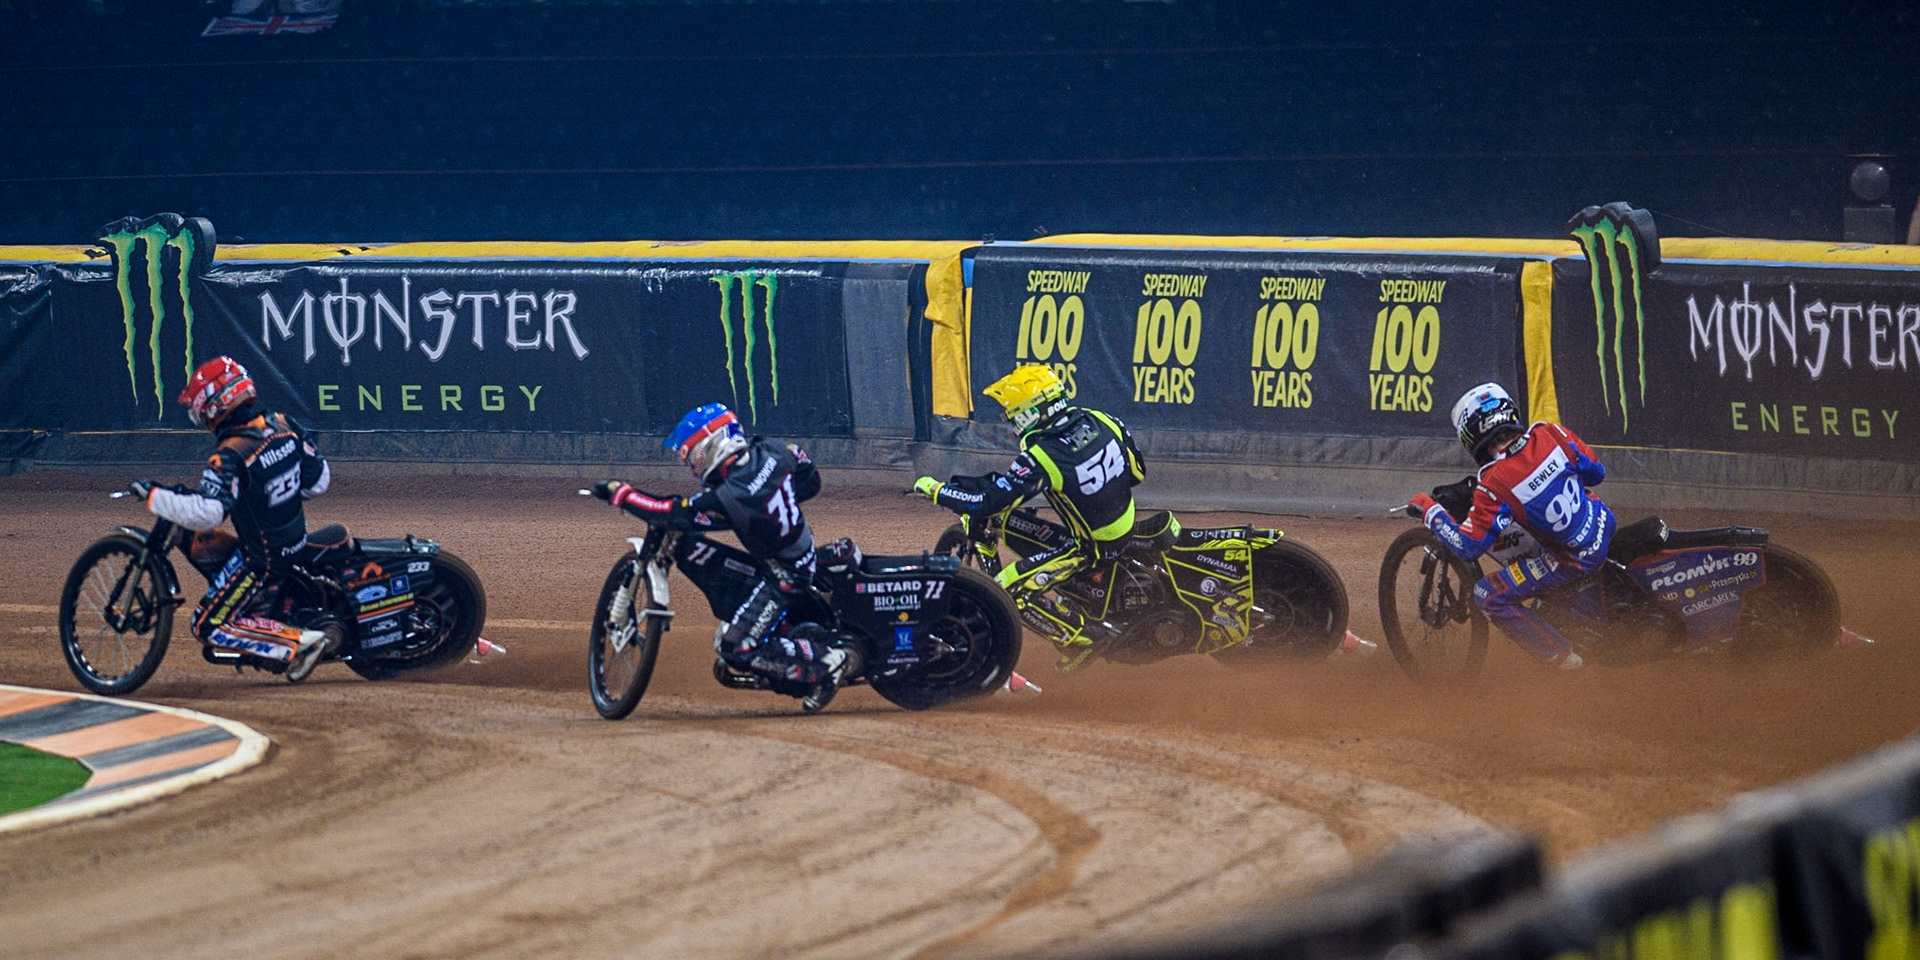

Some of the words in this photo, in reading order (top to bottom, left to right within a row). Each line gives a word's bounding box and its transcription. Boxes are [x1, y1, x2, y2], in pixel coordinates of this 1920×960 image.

[1026, 269, 1091, 294] SPEEDWAY
[1141, 273, 1208, 297] SPEEDWAY
[1259, 276, 1326, 301] SPEEDWAY
[1378, 279, 1446, 303] SPEEDWAY
[258, 275, 589, 366] MONSTER
[1015, 294, 1085, 362] 100
[1132, 298, 1202, 367] 100
[1251, 301, 1320, 370] 100
[1369, 304, 1441, 374] 100
[1687, 281, 1920, 382] MONSTER
[318, 385, 543, 411] ENERGY
[1132, 366, 1196, 405] YEARS
[1251, 370, 1313, 409] YEARS
[1369, 373, 1434, 413] YEARS
[1731, 402, 1899, 439] ENERGY
[1074, 437, 1125, 496] 54
[1527, 458, 1559, 492] BEWLEY
[1545, 474, 1581, 532] 99
[407, 561, 431, 573] 233
[687, 541, 717, 566] 71
[1224, 549, 1248, 561] 54
[1733, 552, 1758, 566] 99
[867, 580, 922, 594] BETARD
[925, 580, 946, 599] 71
